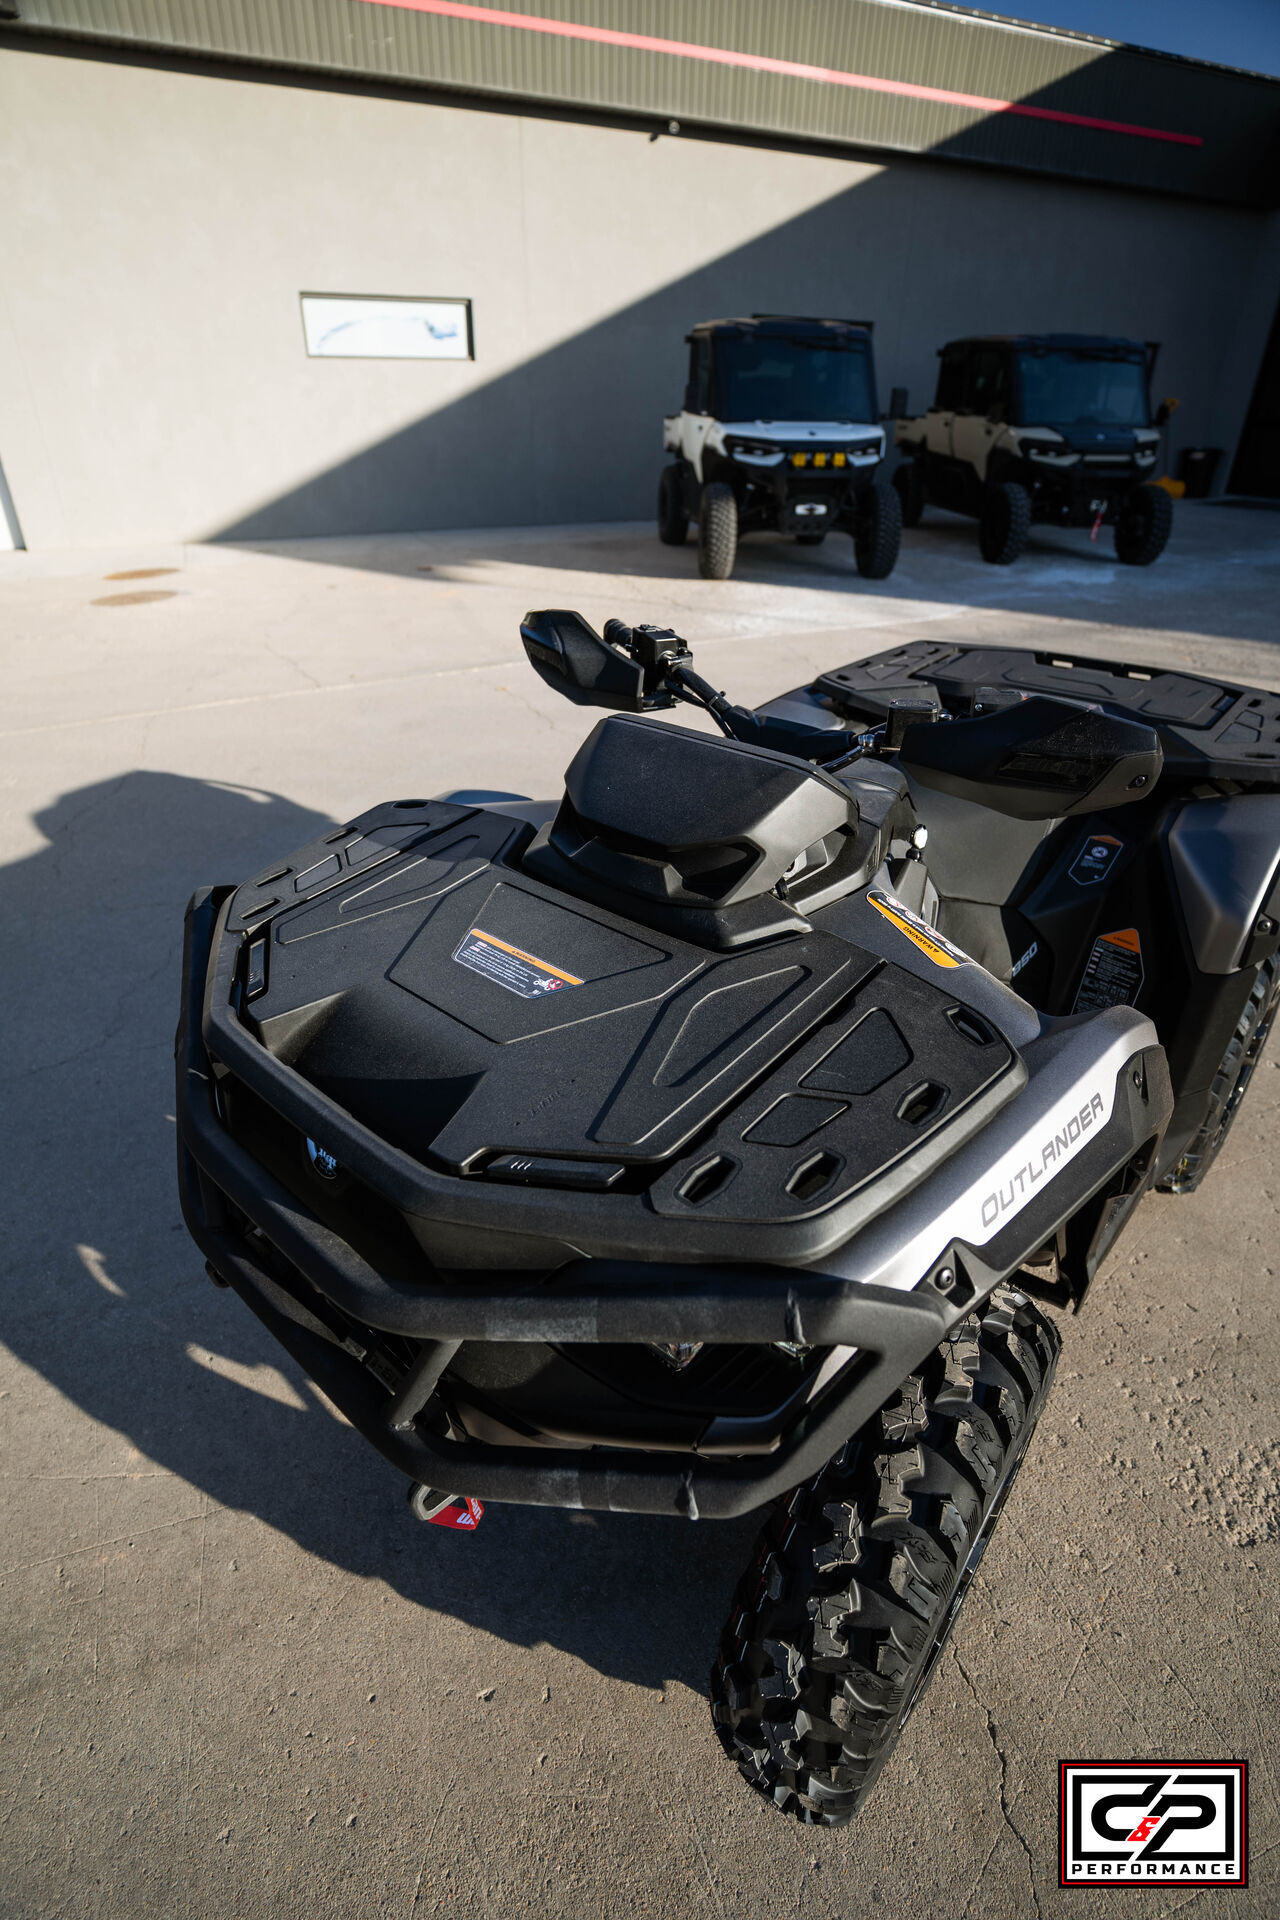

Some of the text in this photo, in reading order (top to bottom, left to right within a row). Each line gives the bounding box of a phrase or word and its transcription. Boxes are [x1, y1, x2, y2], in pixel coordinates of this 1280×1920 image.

[903, 926, 933, 950] WARNING
[1012, 940, 1039, 977] 850
[981, 1092, 1104, 1228] OUTLANDER
